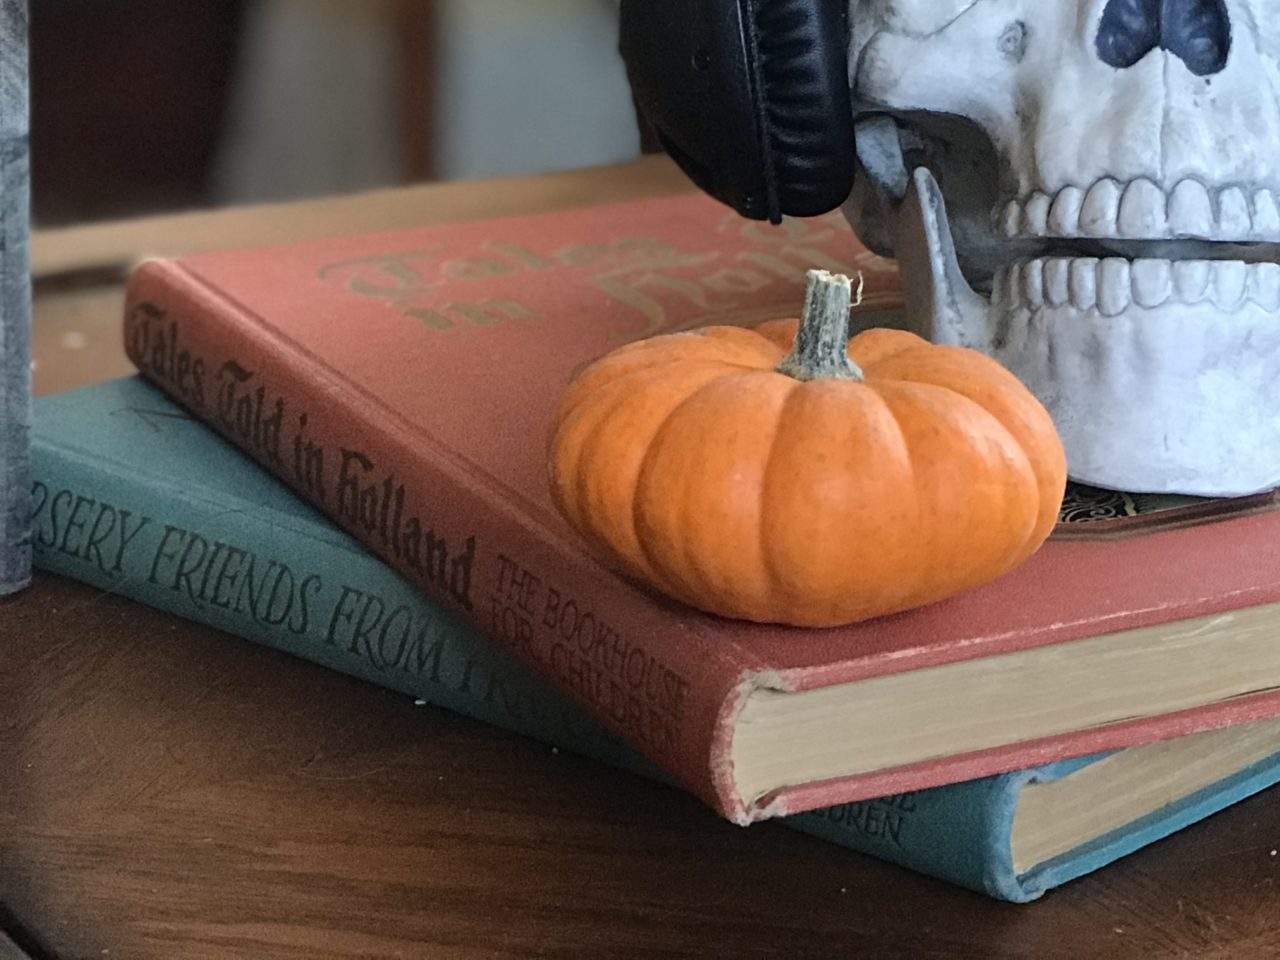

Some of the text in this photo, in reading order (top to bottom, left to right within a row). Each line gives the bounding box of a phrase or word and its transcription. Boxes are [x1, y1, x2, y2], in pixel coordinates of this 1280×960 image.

[131, 301, 476, 612] Tales Told in Holland
[149, 525, 323, 637] FRIENDS
[326, 585, 449, 683] FROM
[489, 596, 544, 662] FOR
[497, 553, 542, 616] THE
[543, 588, 692, 723] BOOKHOUSE
